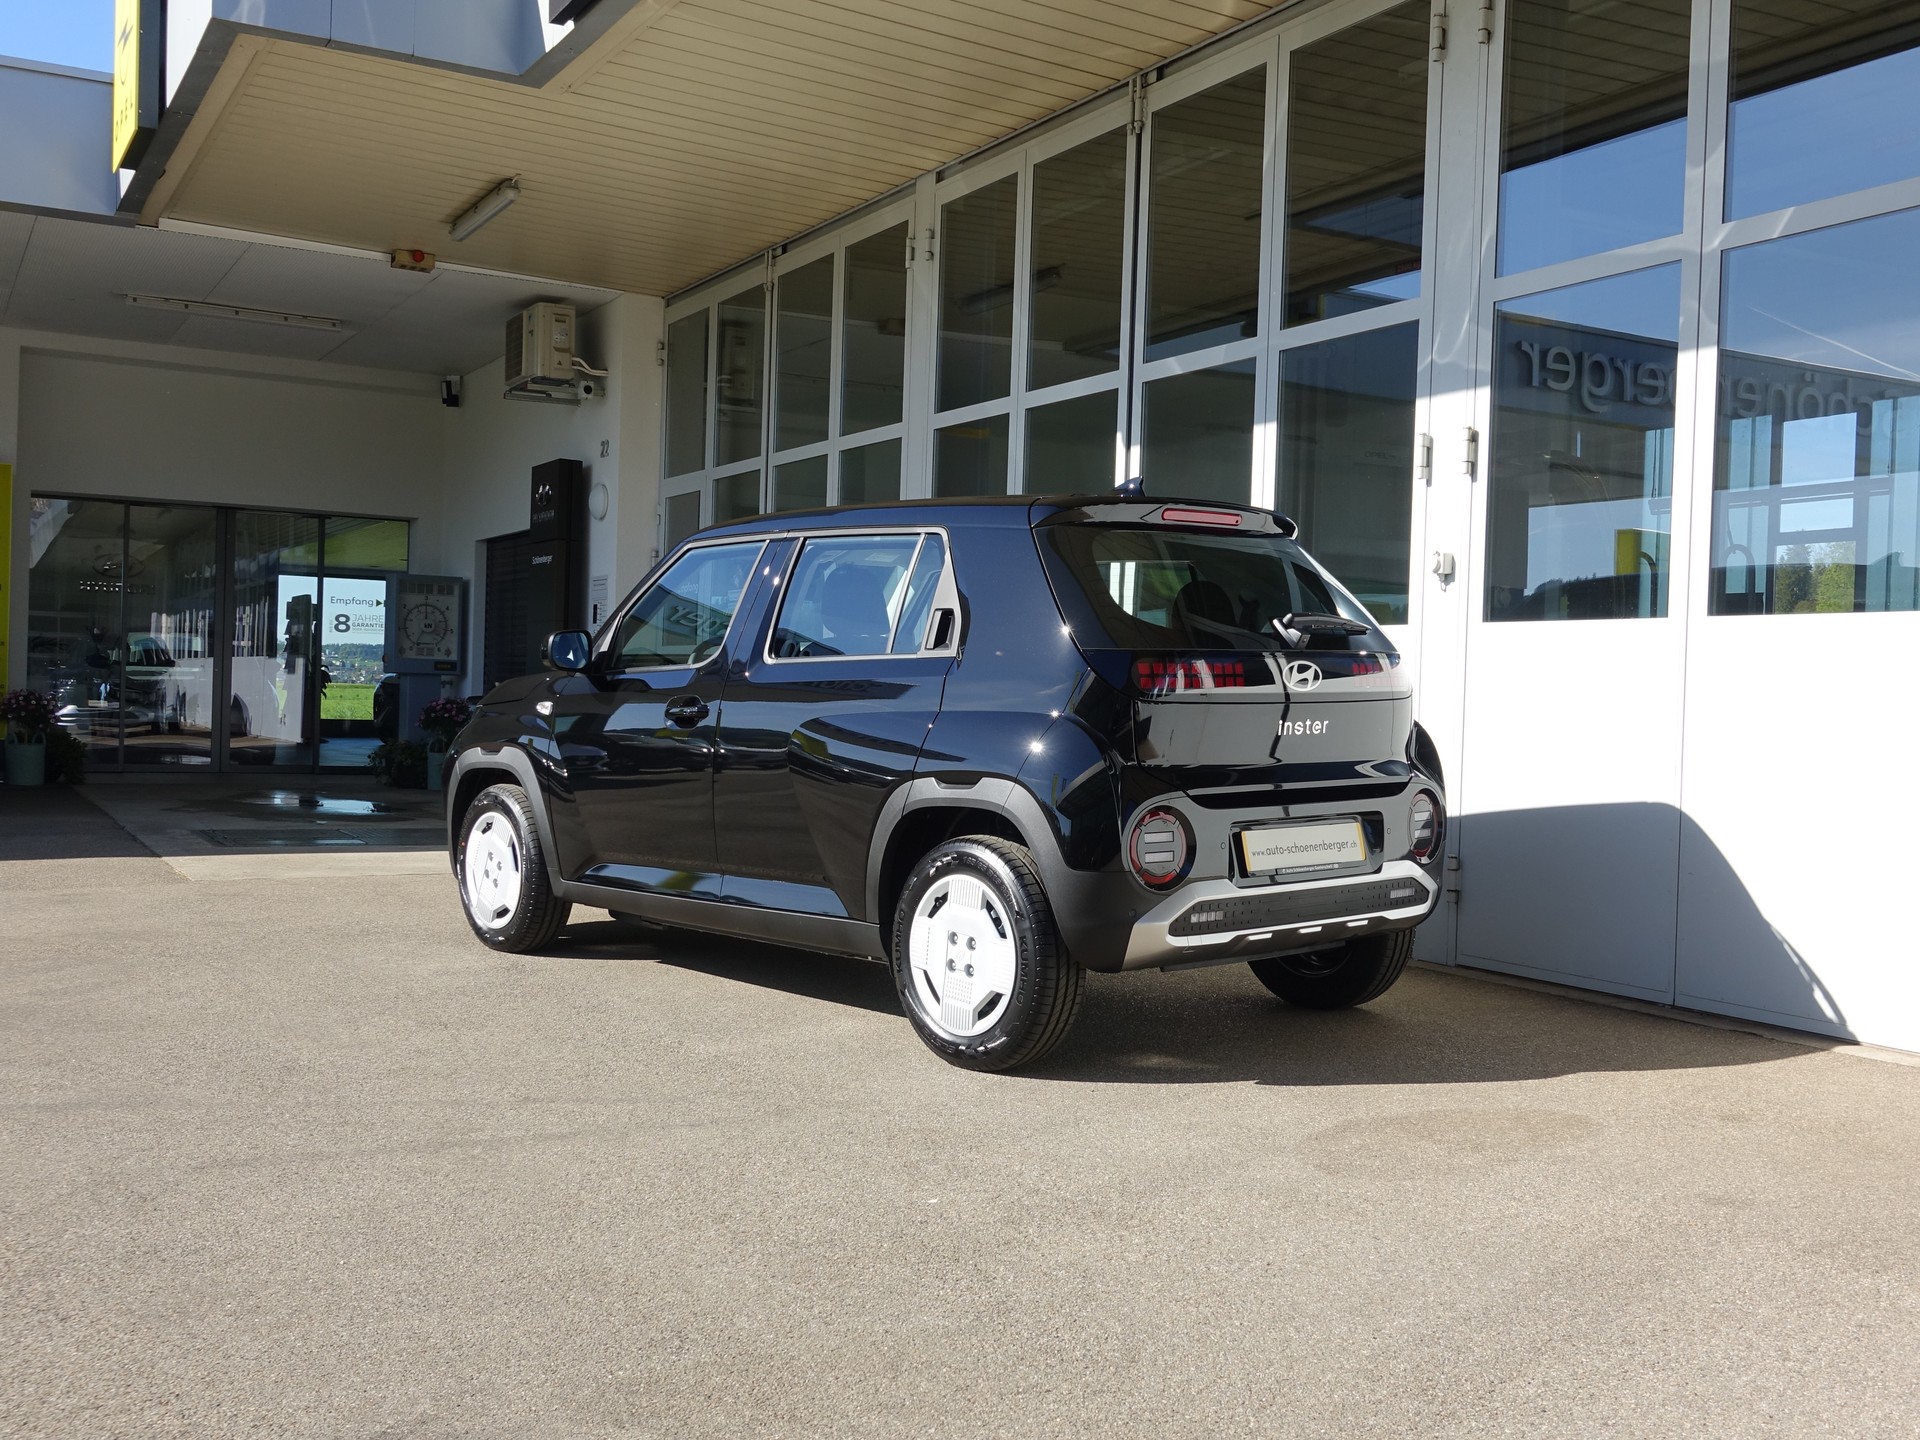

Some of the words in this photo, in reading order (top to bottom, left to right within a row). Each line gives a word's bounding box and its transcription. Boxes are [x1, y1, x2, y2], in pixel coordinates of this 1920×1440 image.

[115, 89, 134, 143] OPEL
[600, 439, 609, 458] 22
[331, 596, 373, 607] Empfang
[334, 613, 350, 633] 8
[352, 614, 384, 623] JAHRE
[1278, 719, 1329, 736] inster
[1251, 840, 1358, 856] www.auto-schoenenberger.ch
[1016, 935, 1029, 1007] KUMHO
